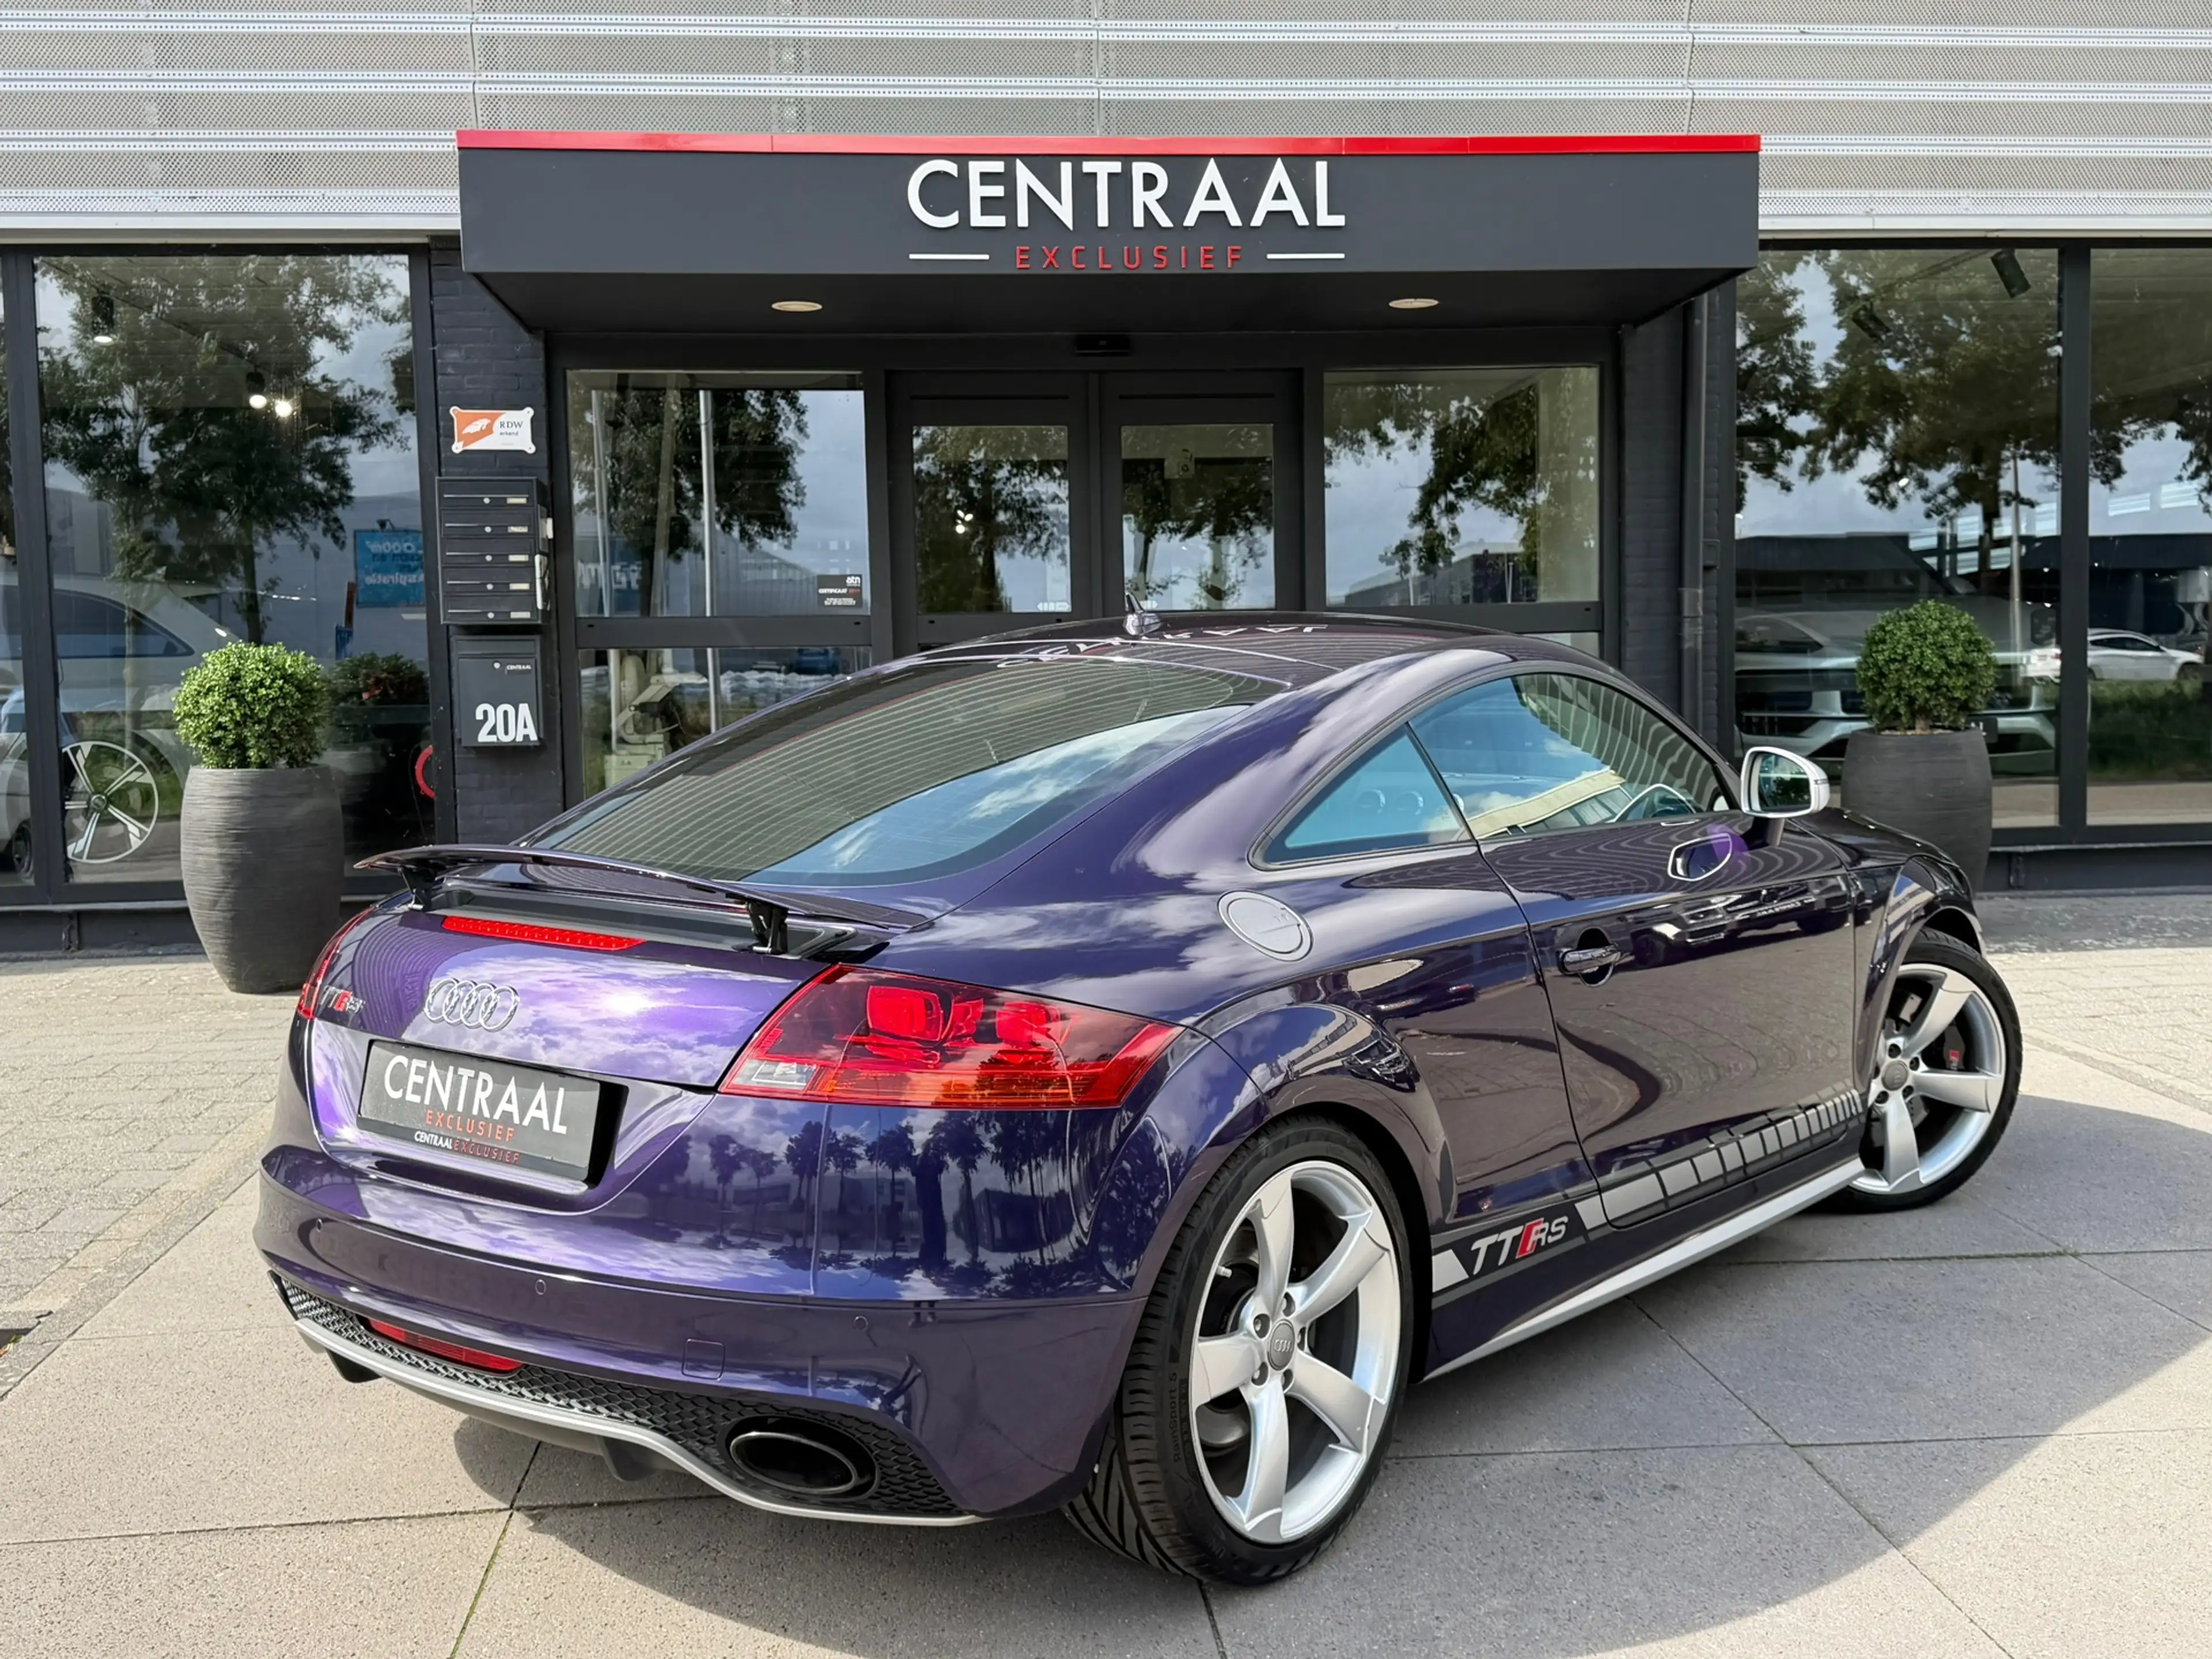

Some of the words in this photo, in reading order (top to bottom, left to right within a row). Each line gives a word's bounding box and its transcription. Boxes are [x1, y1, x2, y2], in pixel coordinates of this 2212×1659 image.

[907, 157, 1346, 230] CENTRAAL
[1015, 245, 1242, 270] EXCLUSIEF
[499, 421, 524, 429] RDW
[475, 703, 538, 743] 20A
[384, 1055, 567, 1134] CENTRAAL
[426, 1109, 514, 1143] EXCLUSIEF
[414, 1131, 453, 1150] CENTRAAL
[453, 1140, 520, 1164] EXCLUSIEF
[1169, 1387, 1182, 1463] RainSport
